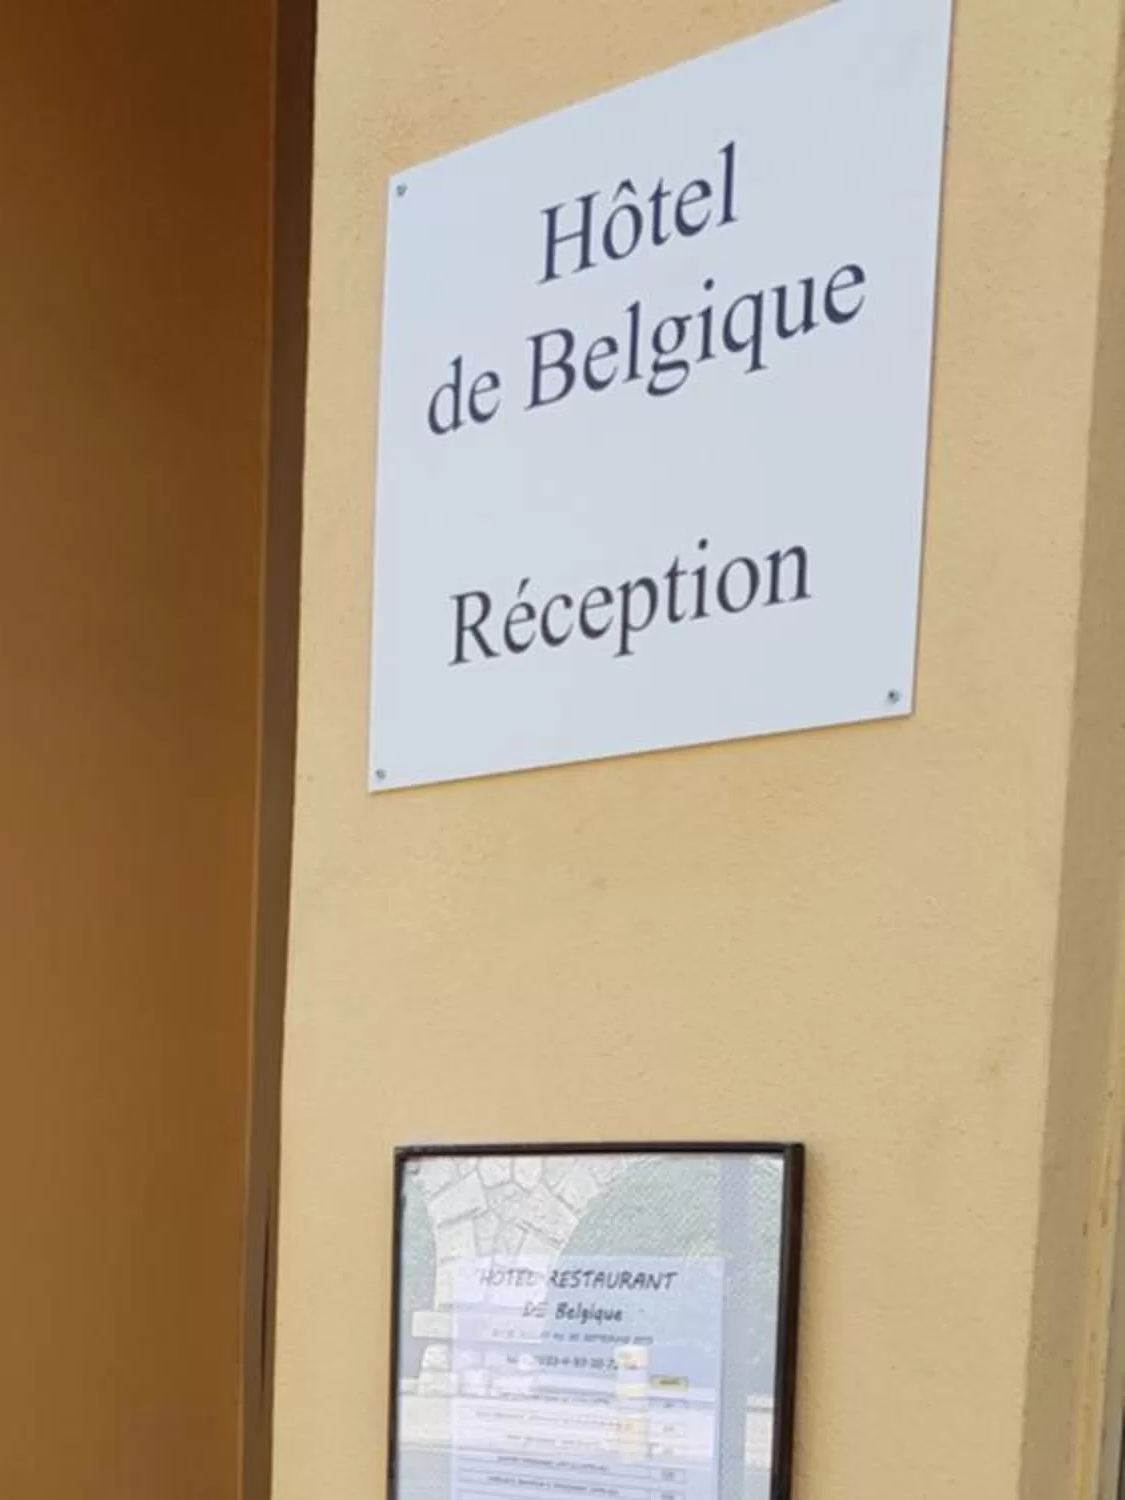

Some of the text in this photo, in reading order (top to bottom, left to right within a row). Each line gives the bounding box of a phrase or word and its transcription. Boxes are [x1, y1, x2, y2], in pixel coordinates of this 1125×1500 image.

[536, 140, 740, 284] Hôtel
[426, 261, 868, 436] de Belgique
[447, 537, 813, 667] Réception
[549, 1269, 679, 1291] RESTAURANT
[554, 1301, 623, 1325] Belgique
